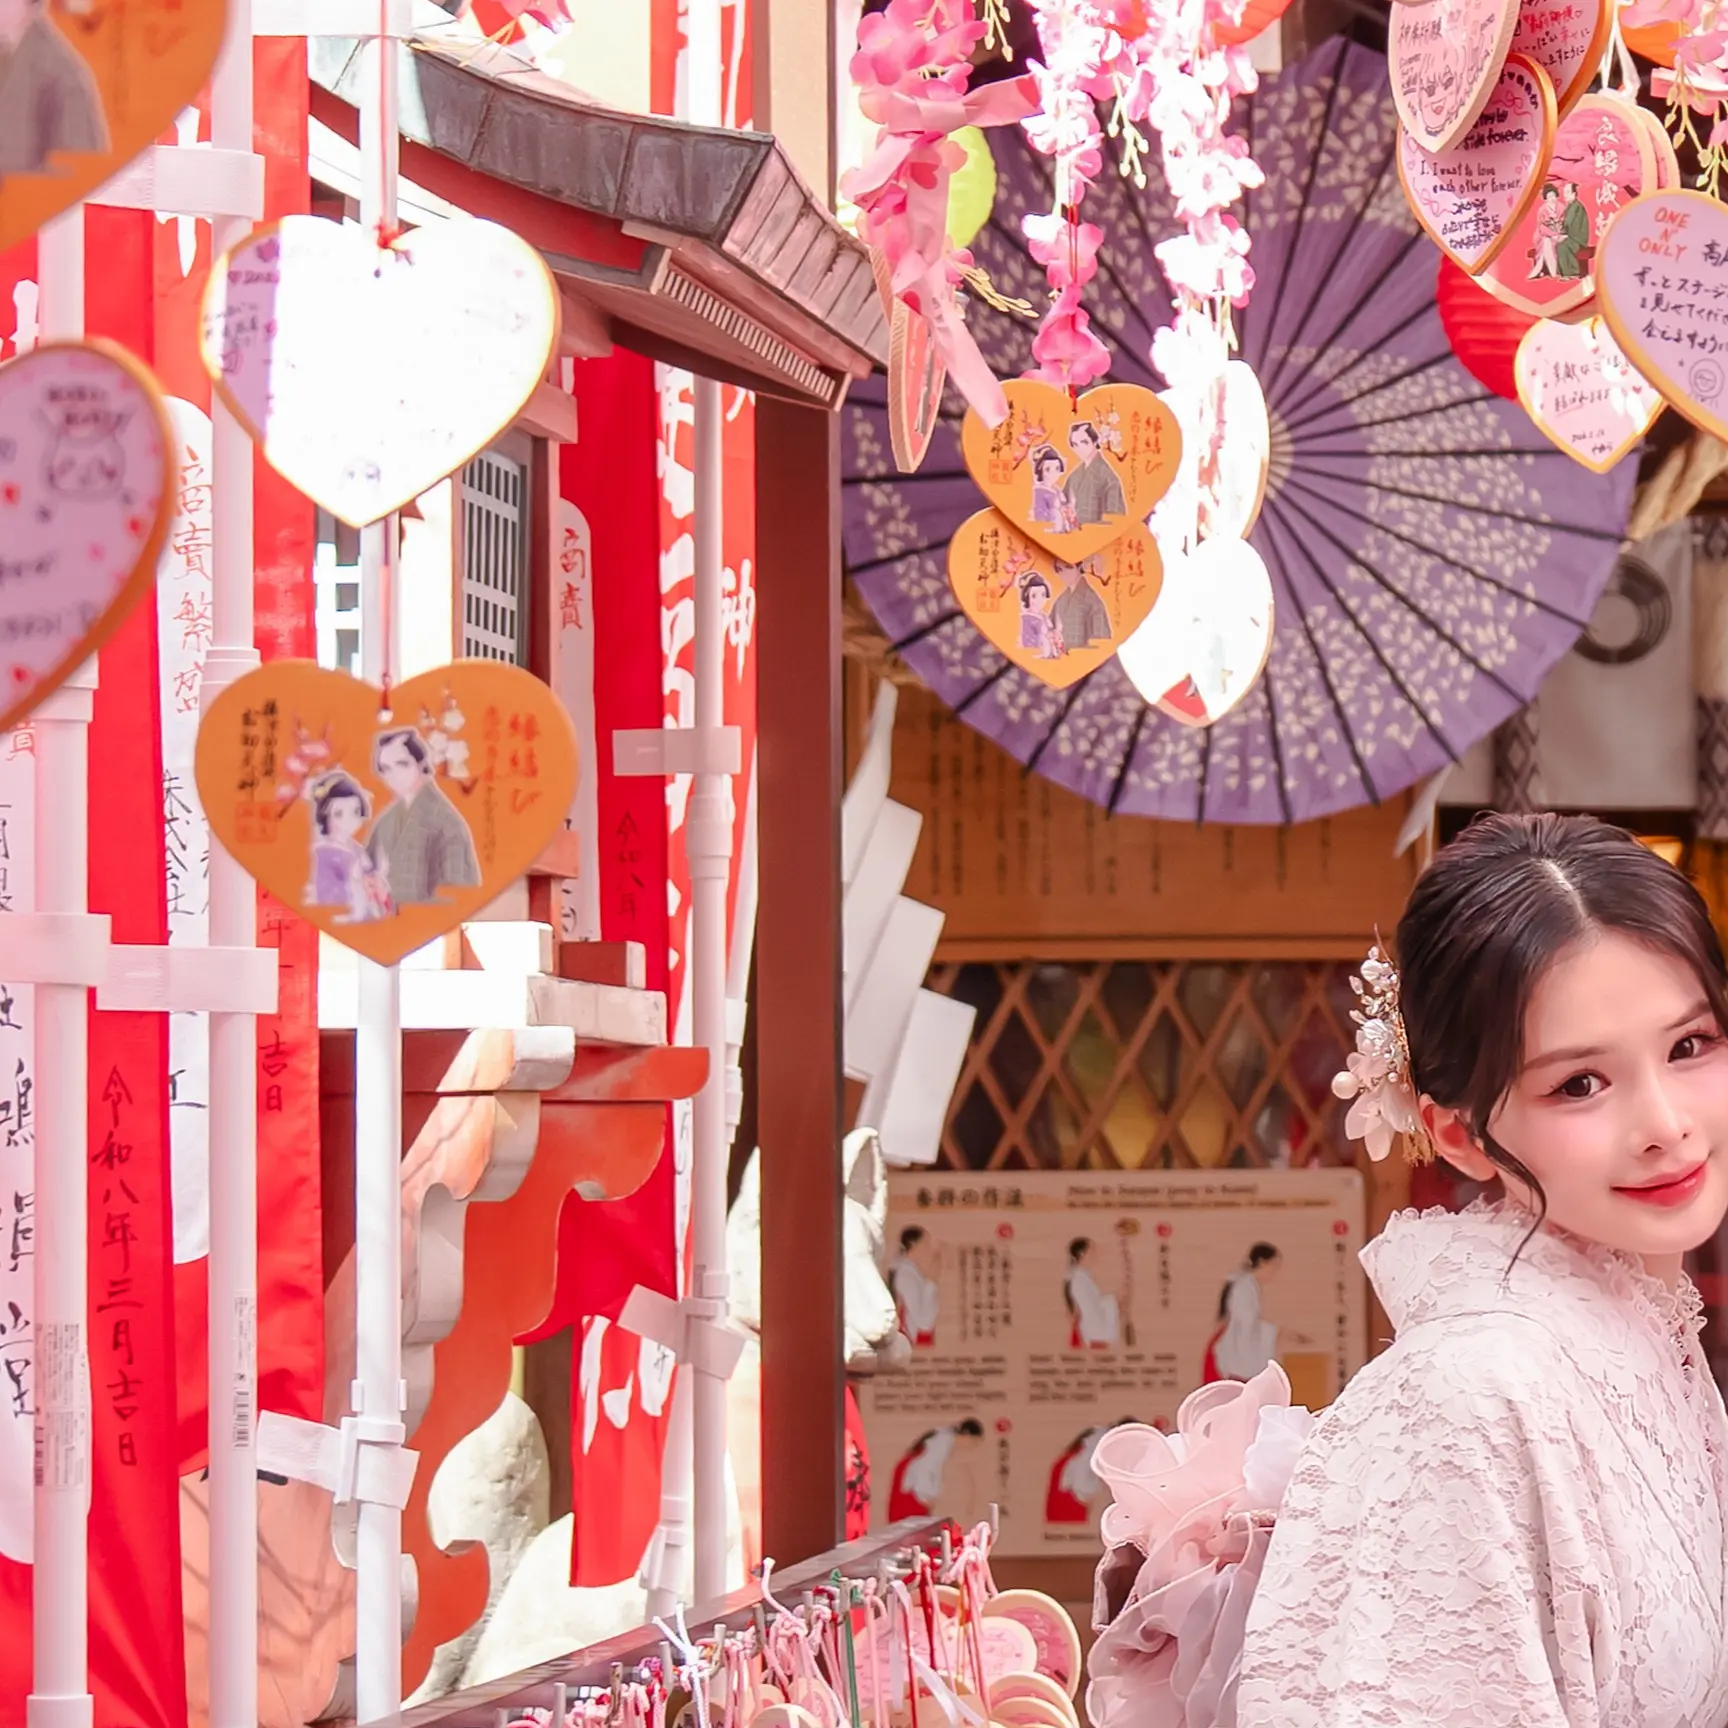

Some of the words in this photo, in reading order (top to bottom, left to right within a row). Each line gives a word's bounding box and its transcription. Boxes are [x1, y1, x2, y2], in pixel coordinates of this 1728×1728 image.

[1655, 207, 1691, 229] ONE
[1638, 237, 1688, 262] ONLY
[92, 1062, 145, 1468] 令和八年三月吉日
